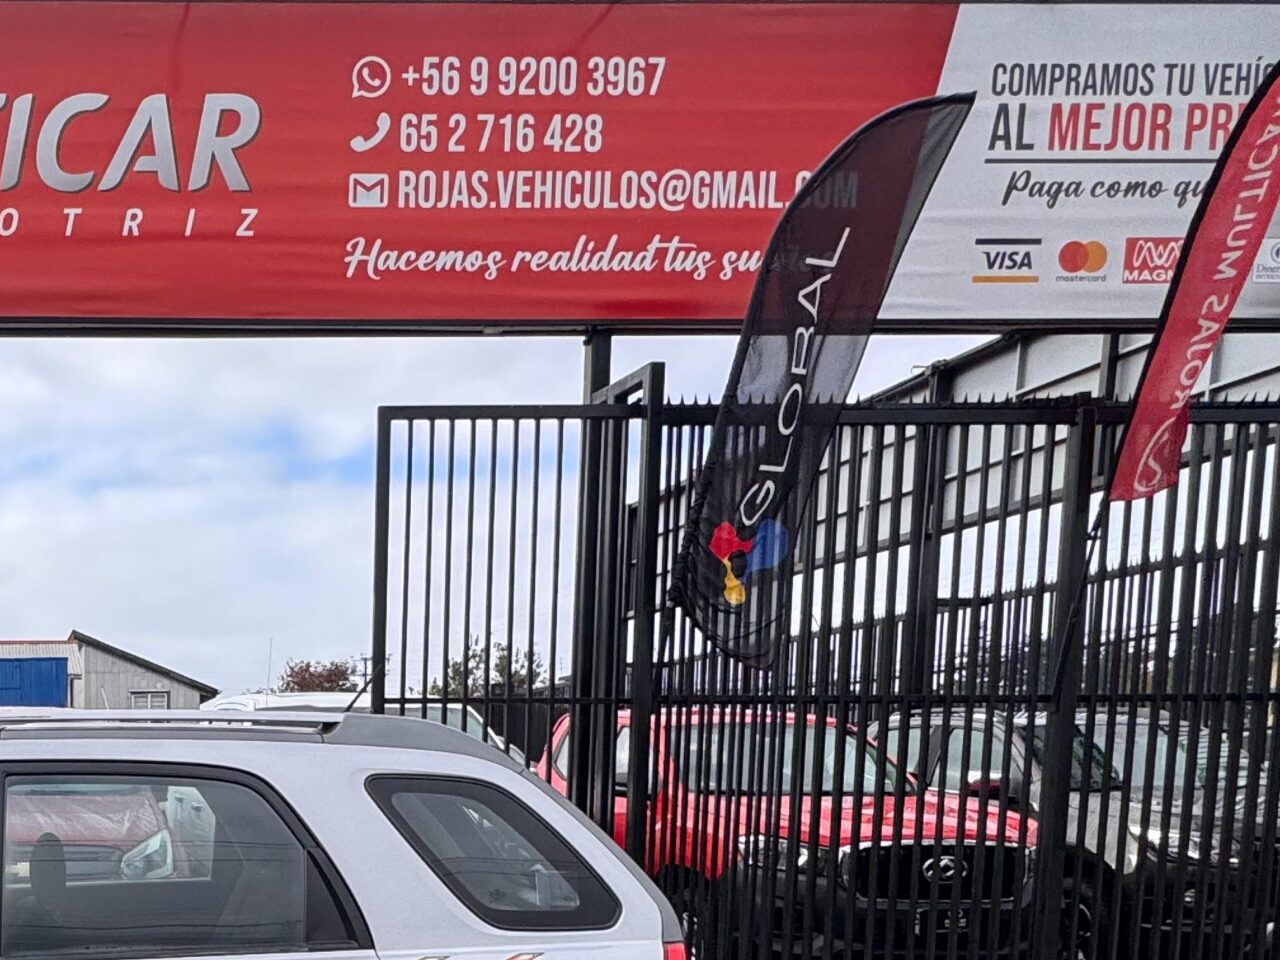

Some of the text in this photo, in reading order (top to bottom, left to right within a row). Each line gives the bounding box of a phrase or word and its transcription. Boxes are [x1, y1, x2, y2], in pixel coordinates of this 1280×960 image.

[401, 56, 667, 97] +56 9 9200 3967
[991, 62, 1156, 97] COMPRAMOS
[1164, 62, 1196, 97] TU
[399, 113, 603, 153] 65 2 716 428
[988, 102, 1249, 152] AL MEJOR PR
[1001, 170, 1086, 210] Paga
[1090, 179, 1169, 199] como
[343, 235, 507, 281] Hacemos
[510, 234, 658, 274] realidad
[648, 241, 718, 280] tus
[981, 251, 1033, 270] VISA
[1055, 274, 1107, 283] mastercard
[739, 226, 851, 527] GLOBAL
